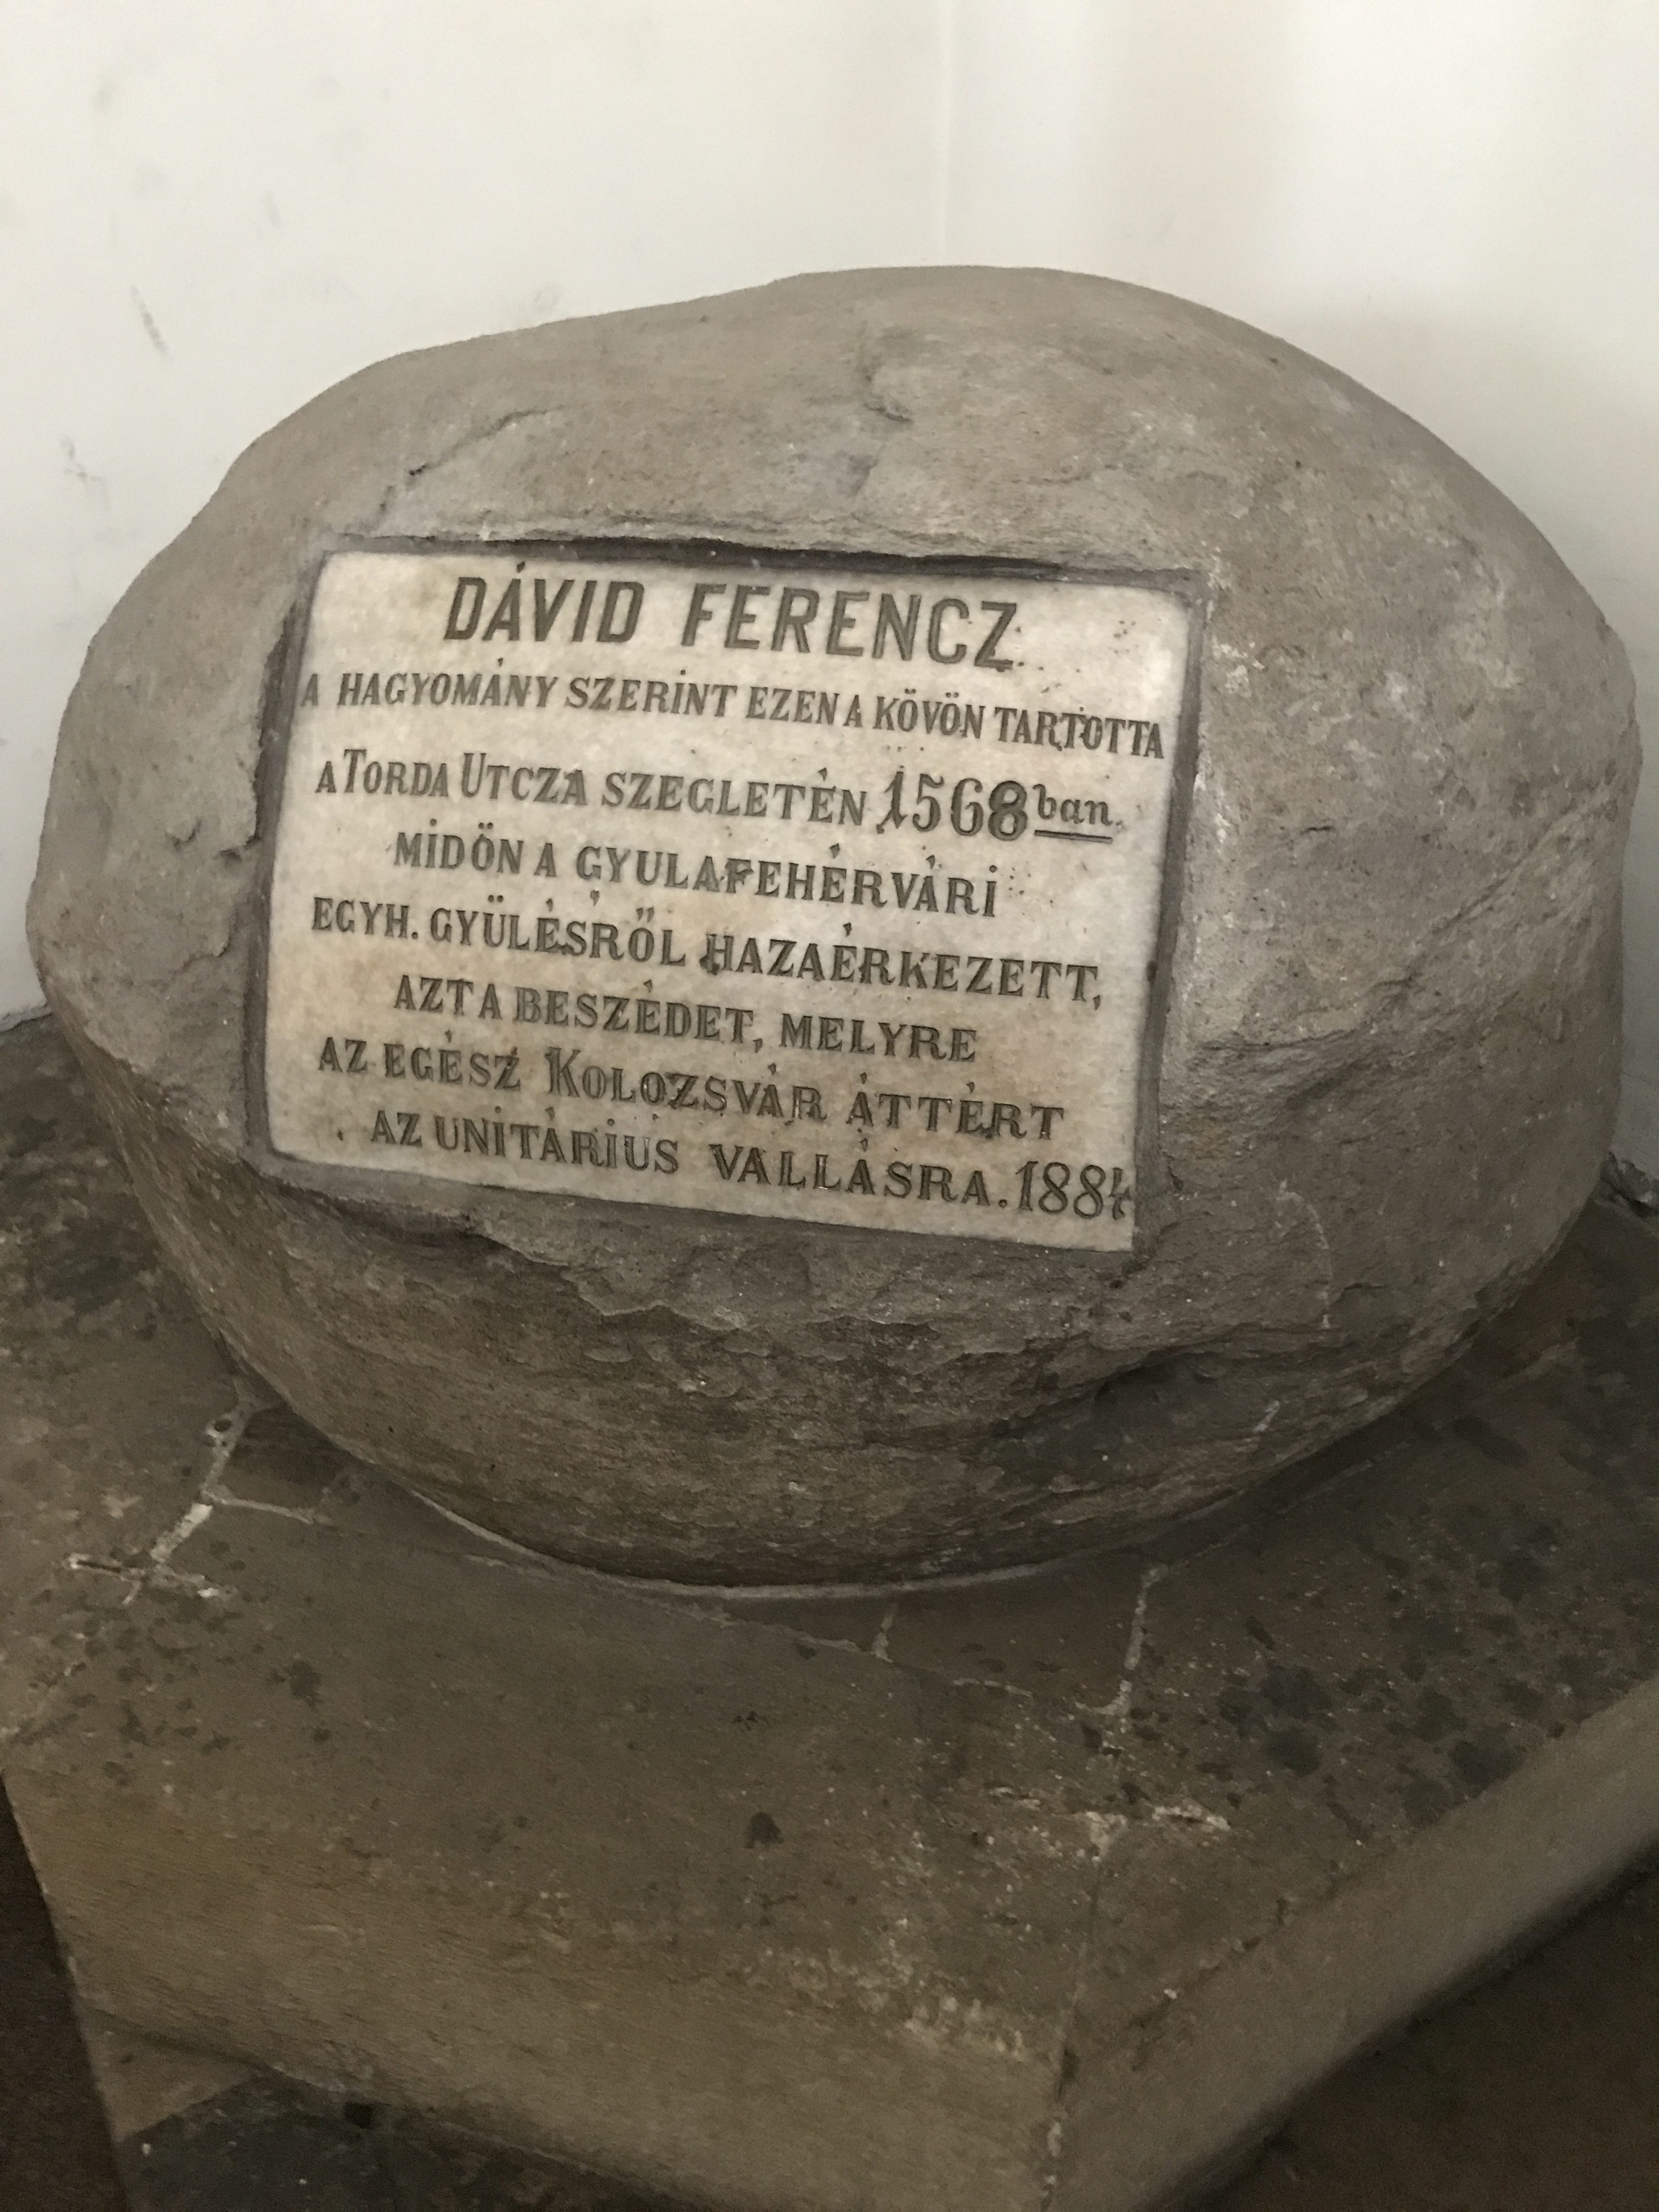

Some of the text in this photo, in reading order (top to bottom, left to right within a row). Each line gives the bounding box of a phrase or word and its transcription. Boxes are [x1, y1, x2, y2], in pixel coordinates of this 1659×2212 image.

[444, 561, 645, 642] DÁVID
[301, 673, 319, 707] A
[337, 657, 558, 708] HAGYOMÁNY
[746, 686, 840, 725] EZEN
[843, 693, 863, 728] A
[873, 687, 985, 739] KÖVÖN
[994, 707, 1165, 759] TARTOTTA
[315, 761, 337, 794] A
[601, 767, 867, 826] SZEGLETÉN
[312, 896, 419, 940] EGYH.
[534, 843, 557, 877] A
[576, 844, 997, 918] GYULAFEHÉRVÁRI
[394, 974, 978, 1062] AZT A BESZÉDET, MELYRE
[318, 1037, 368, 1073] AZ
[384, 1030, 522, 1090] EGÉSZ
[845, 1071, 1064, 1140] ÁTTÉRT
[370, 1111, 422, 1147] AZ
[434, 1106, 679, 1173] UNITÁRIUS
[708, 1136, 1007, 1209] VALLÁSRA.
